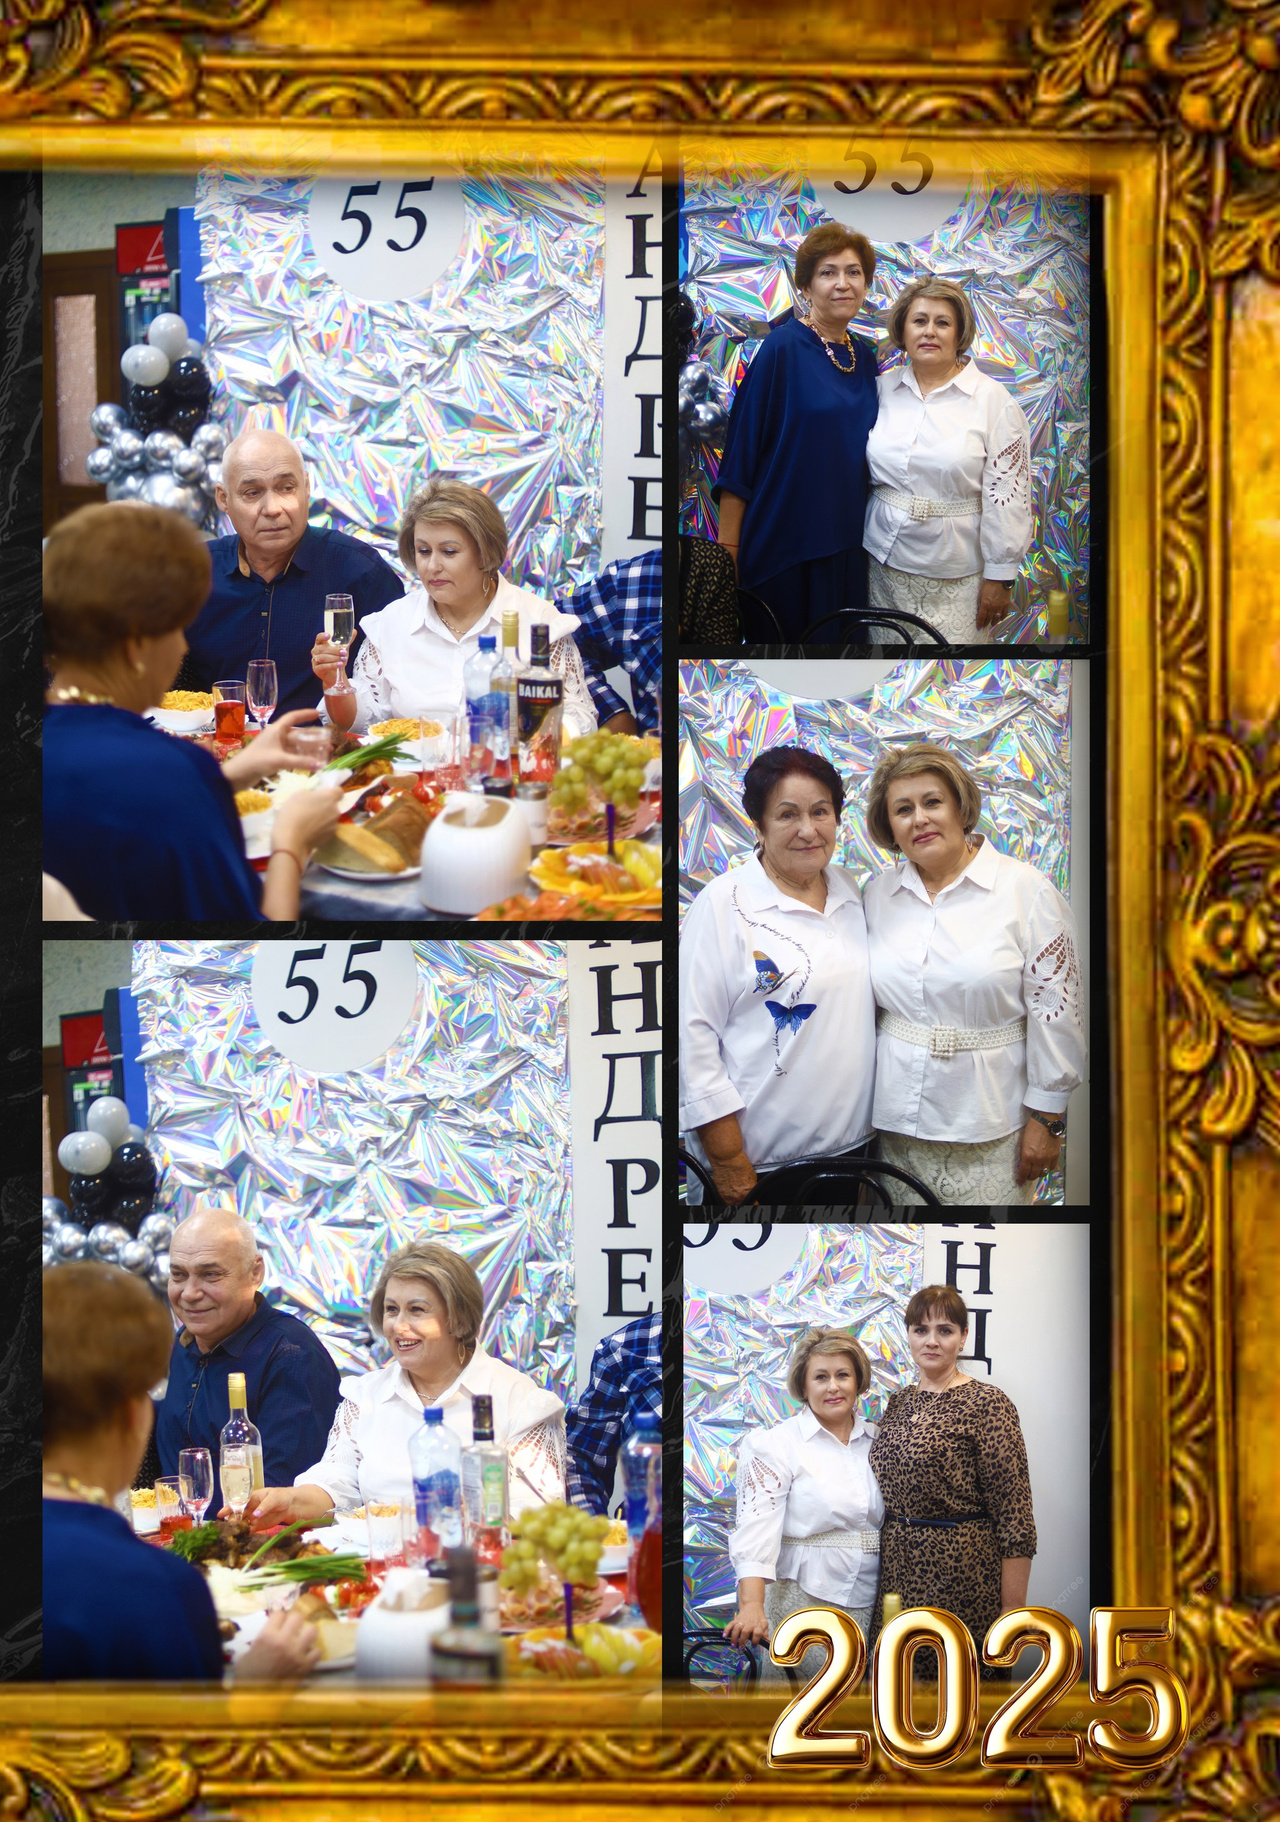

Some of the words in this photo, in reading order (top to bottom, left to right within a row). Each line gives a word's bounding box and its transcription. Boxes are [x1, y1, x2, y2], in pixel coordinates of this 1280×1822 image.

[332, 176, 435, 254] 55
[519, 683, 560, 698] BAIKAL
[277, 940, 383, 1024] 55
[589, 940, 663, 1318] НДРЕ
